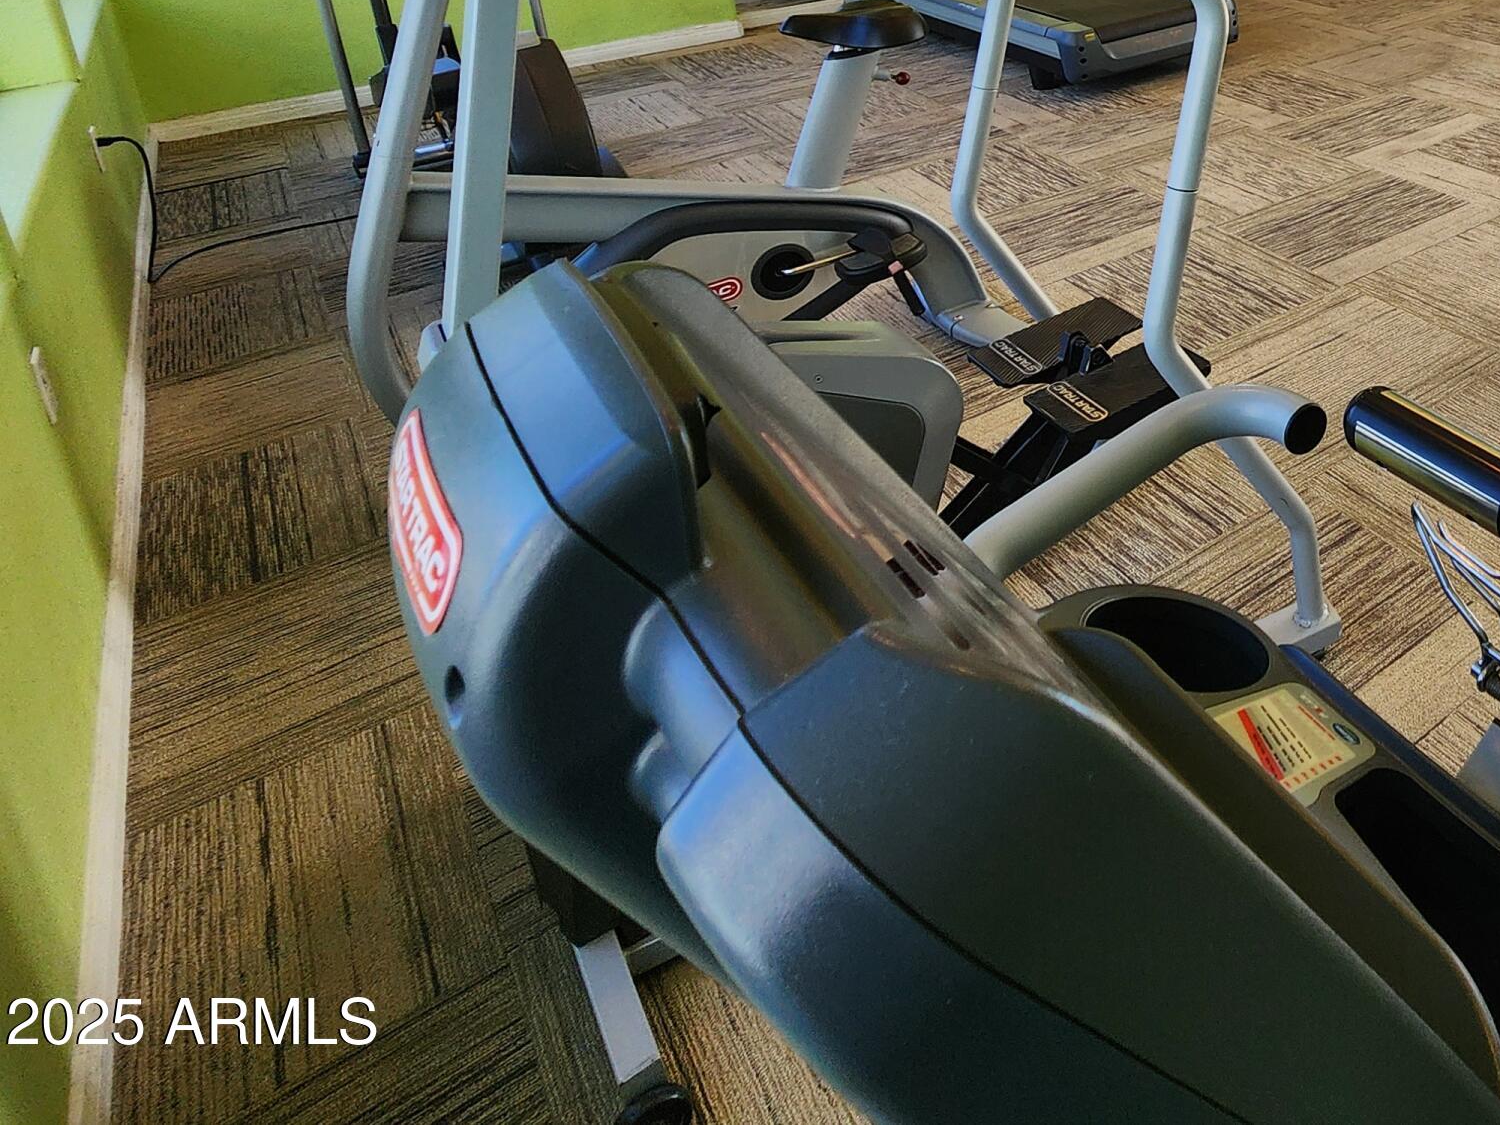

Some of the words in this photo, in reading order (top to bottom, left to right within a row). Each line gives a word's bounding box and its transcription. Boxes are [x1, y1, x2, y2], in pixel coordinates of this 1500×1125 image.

[994, 341, 1017, 359] TRAC
[1014, 355, 1038, 372] STAR
[1053, 385, 1077, 404] TRAC
[1074, 398, 1102, 418] STAR
[406, 496, 446, 593] TRAC
